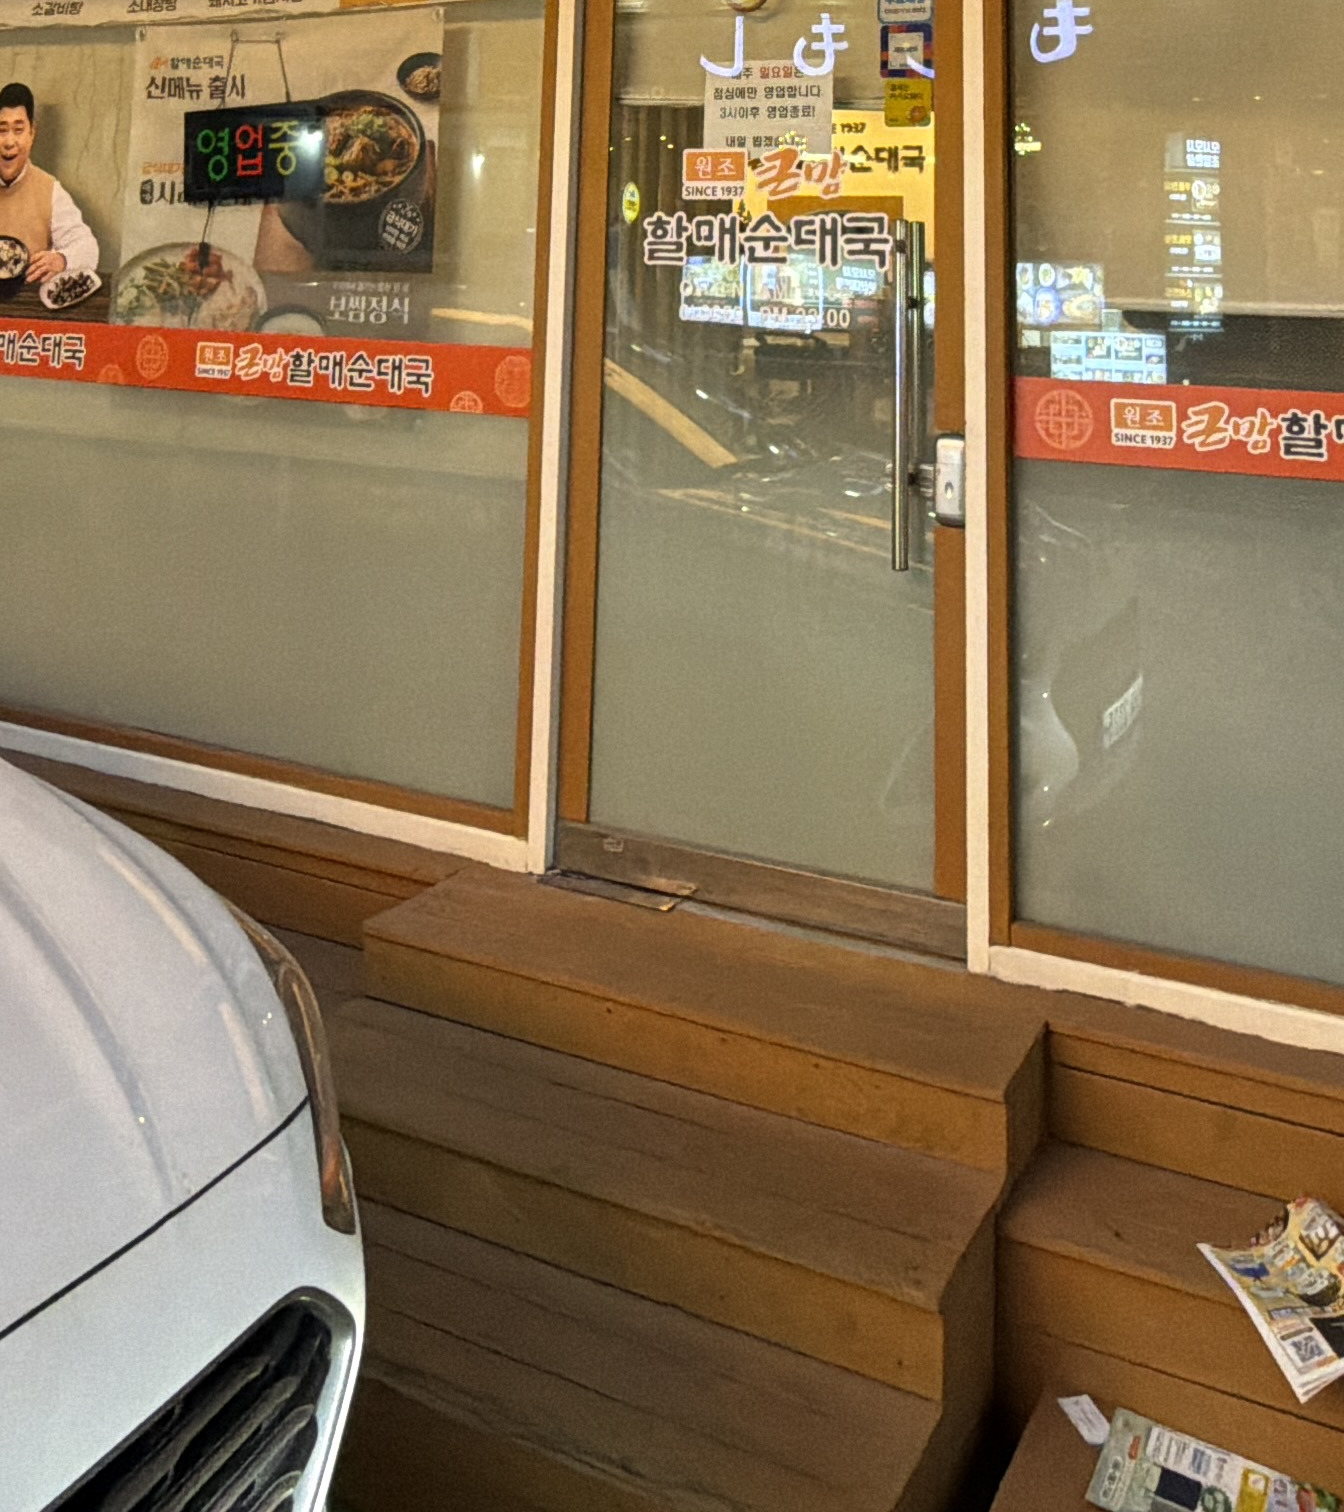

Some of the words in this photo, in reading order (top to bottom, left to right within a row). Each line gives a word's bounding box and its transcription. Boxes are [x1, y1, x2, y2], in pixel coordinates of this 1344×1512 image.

[146, 76, 203, 100] 신메뉴
[207, 74, 246, 100] 출시
[713, 87, 757, 101] 점심에만
[719, 106, 760, 120] 3시이후
[196, 120, 303, 182] 영업중
[725, 135, 747, 149] 내일
[695, 156, 737, 178] 원조
[755, 147, 848, 199] 큰맘
[684, 186, 718, 198] SINCE
[720, 186, 745, 198] 1937
[644, 212, 892, 270] 할매순대국
[287, 349, 433, 396] 할매순대국
[1121, 405, 1165, 428] 원조
[1182, 403, 1275, 453] 큰맘
[1114, 433, 1148, 446] SINCE
[1149, 435, 1175, 447] 1937
